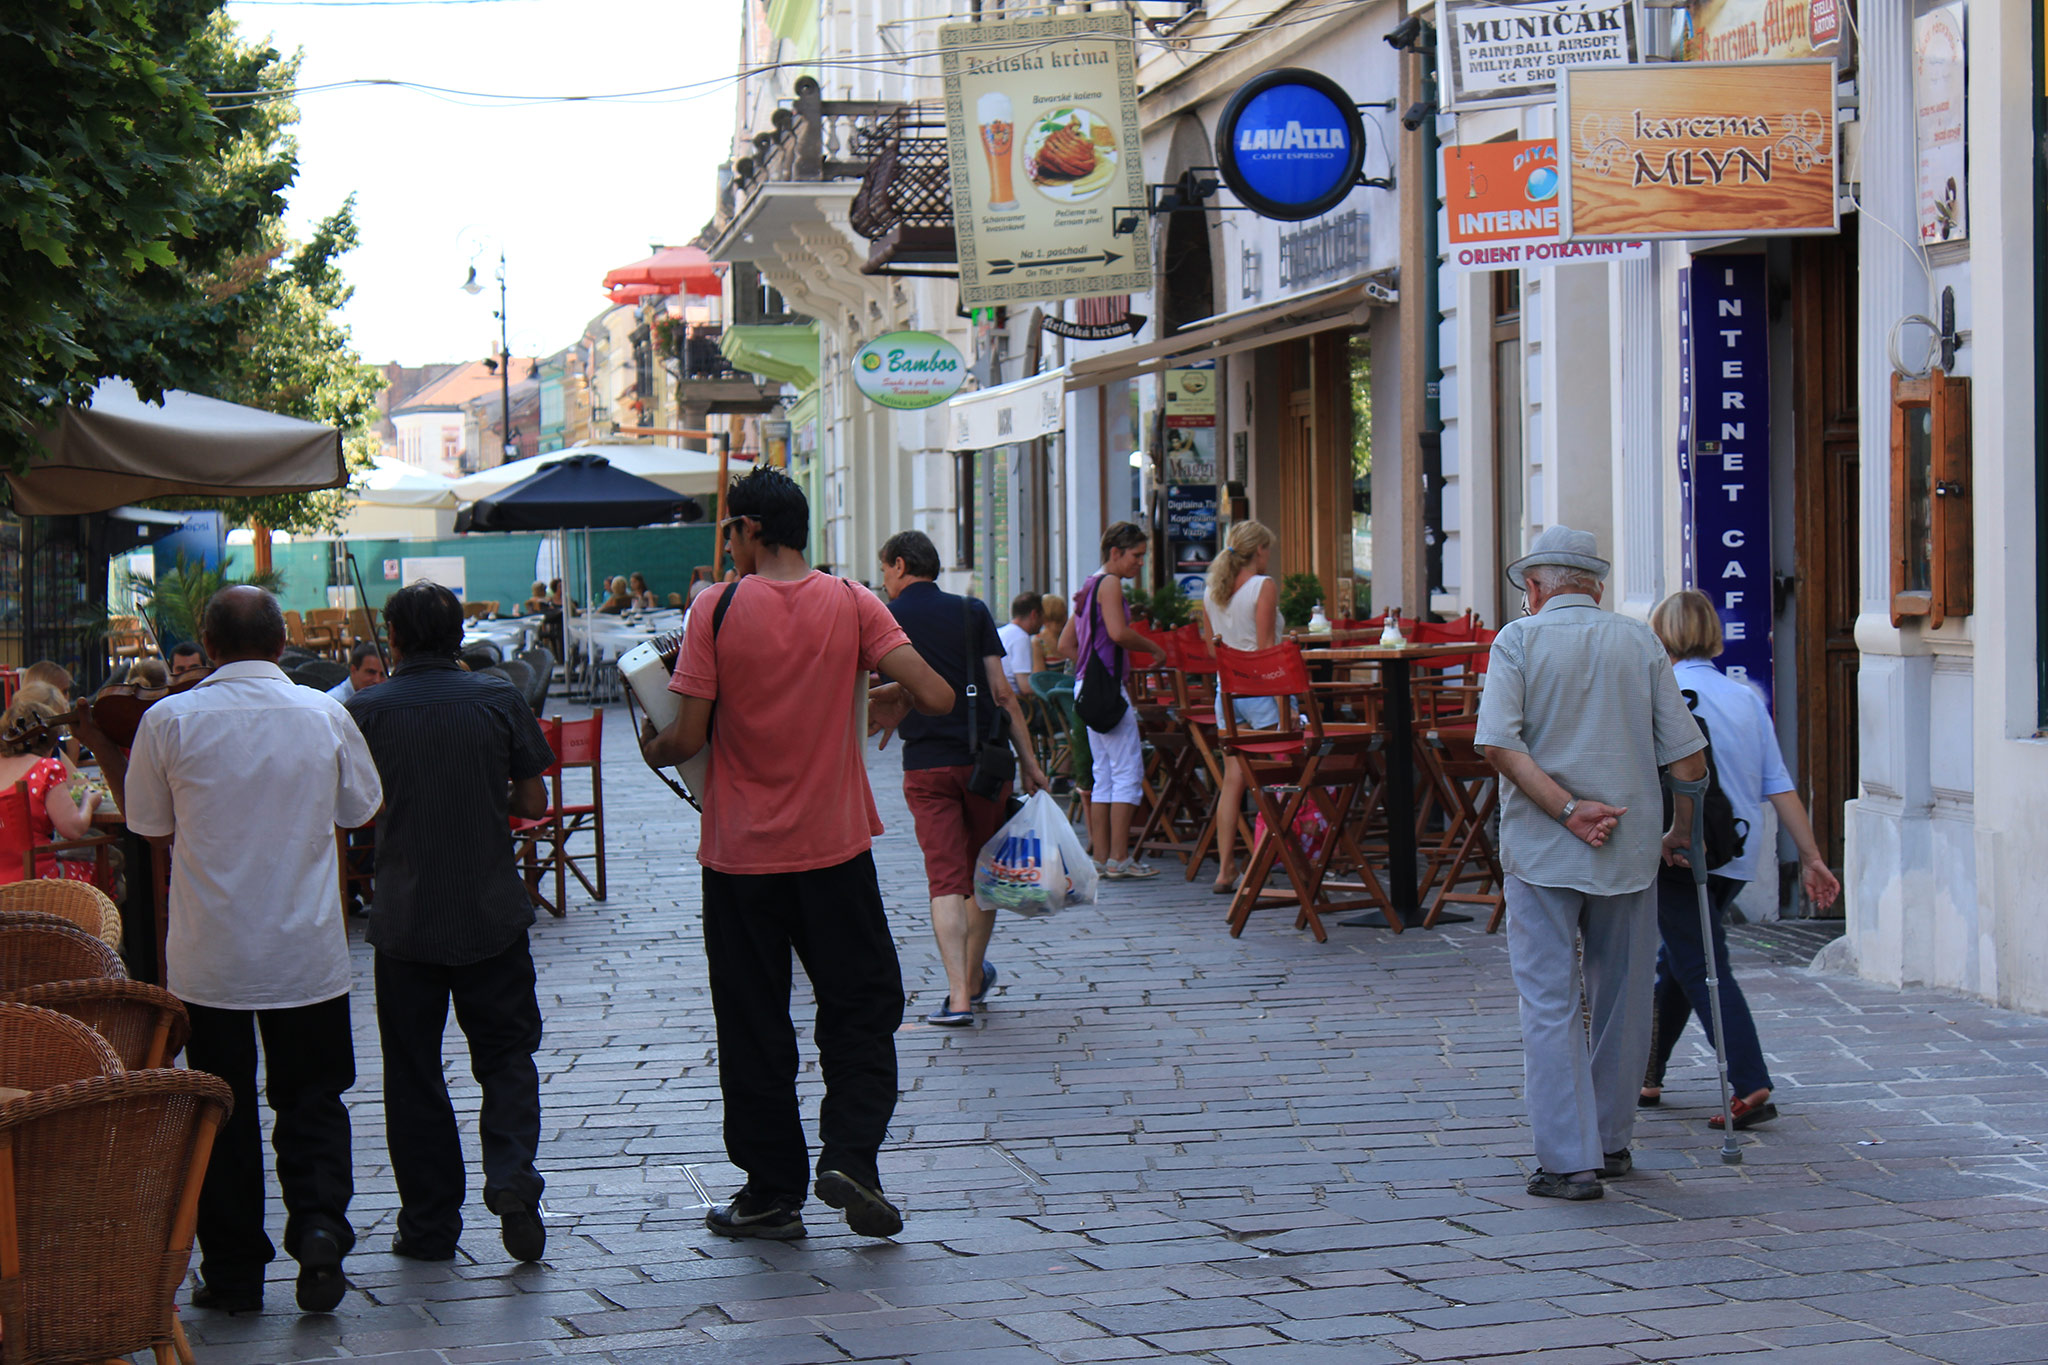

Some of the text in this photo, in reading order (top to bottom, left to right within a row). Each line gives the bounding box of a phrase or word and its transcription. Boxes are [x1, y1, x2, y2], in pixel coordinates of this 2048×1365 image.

[1813, 0, 1834, 18] STELLA
[1462, 4, 1621, 44] MUNIČÁK
[1814, 14, 1835, 35] ARTOIS
[1469, 34, 1619, 59] PAINTBALL AIRSOFT
[1469, 48, 1621, 73] MILITARY SURVIVAL
[1527, 69, 1556, 81] SHO
[1239, 120, 1345, 150] LAVAZZA
[1632, 107, 1771, 141] karczma
[1513, 145, 1558, 172] DIYA
[1631, 144, 1772, 188] MLYN
[1020, 249, 1033, 259] Na
[1458, 241, 1623, 266] ORIENT POTRAVINY
[1025, 269, 1037, 277] On
[1039, 267, 1053, 276] The
[1066, 265, 1086, 274] Floor
[887, 349, 958, 373] Bamboo
[1680, 281, 1689, 499] INTERNET
[1717, 268, 1746, 502] INTERNET
[1721, 529, 1747, 640] CAFE
[1725, 665, 1748, 681] B
[991, 860, 1041, 882] TESCO
